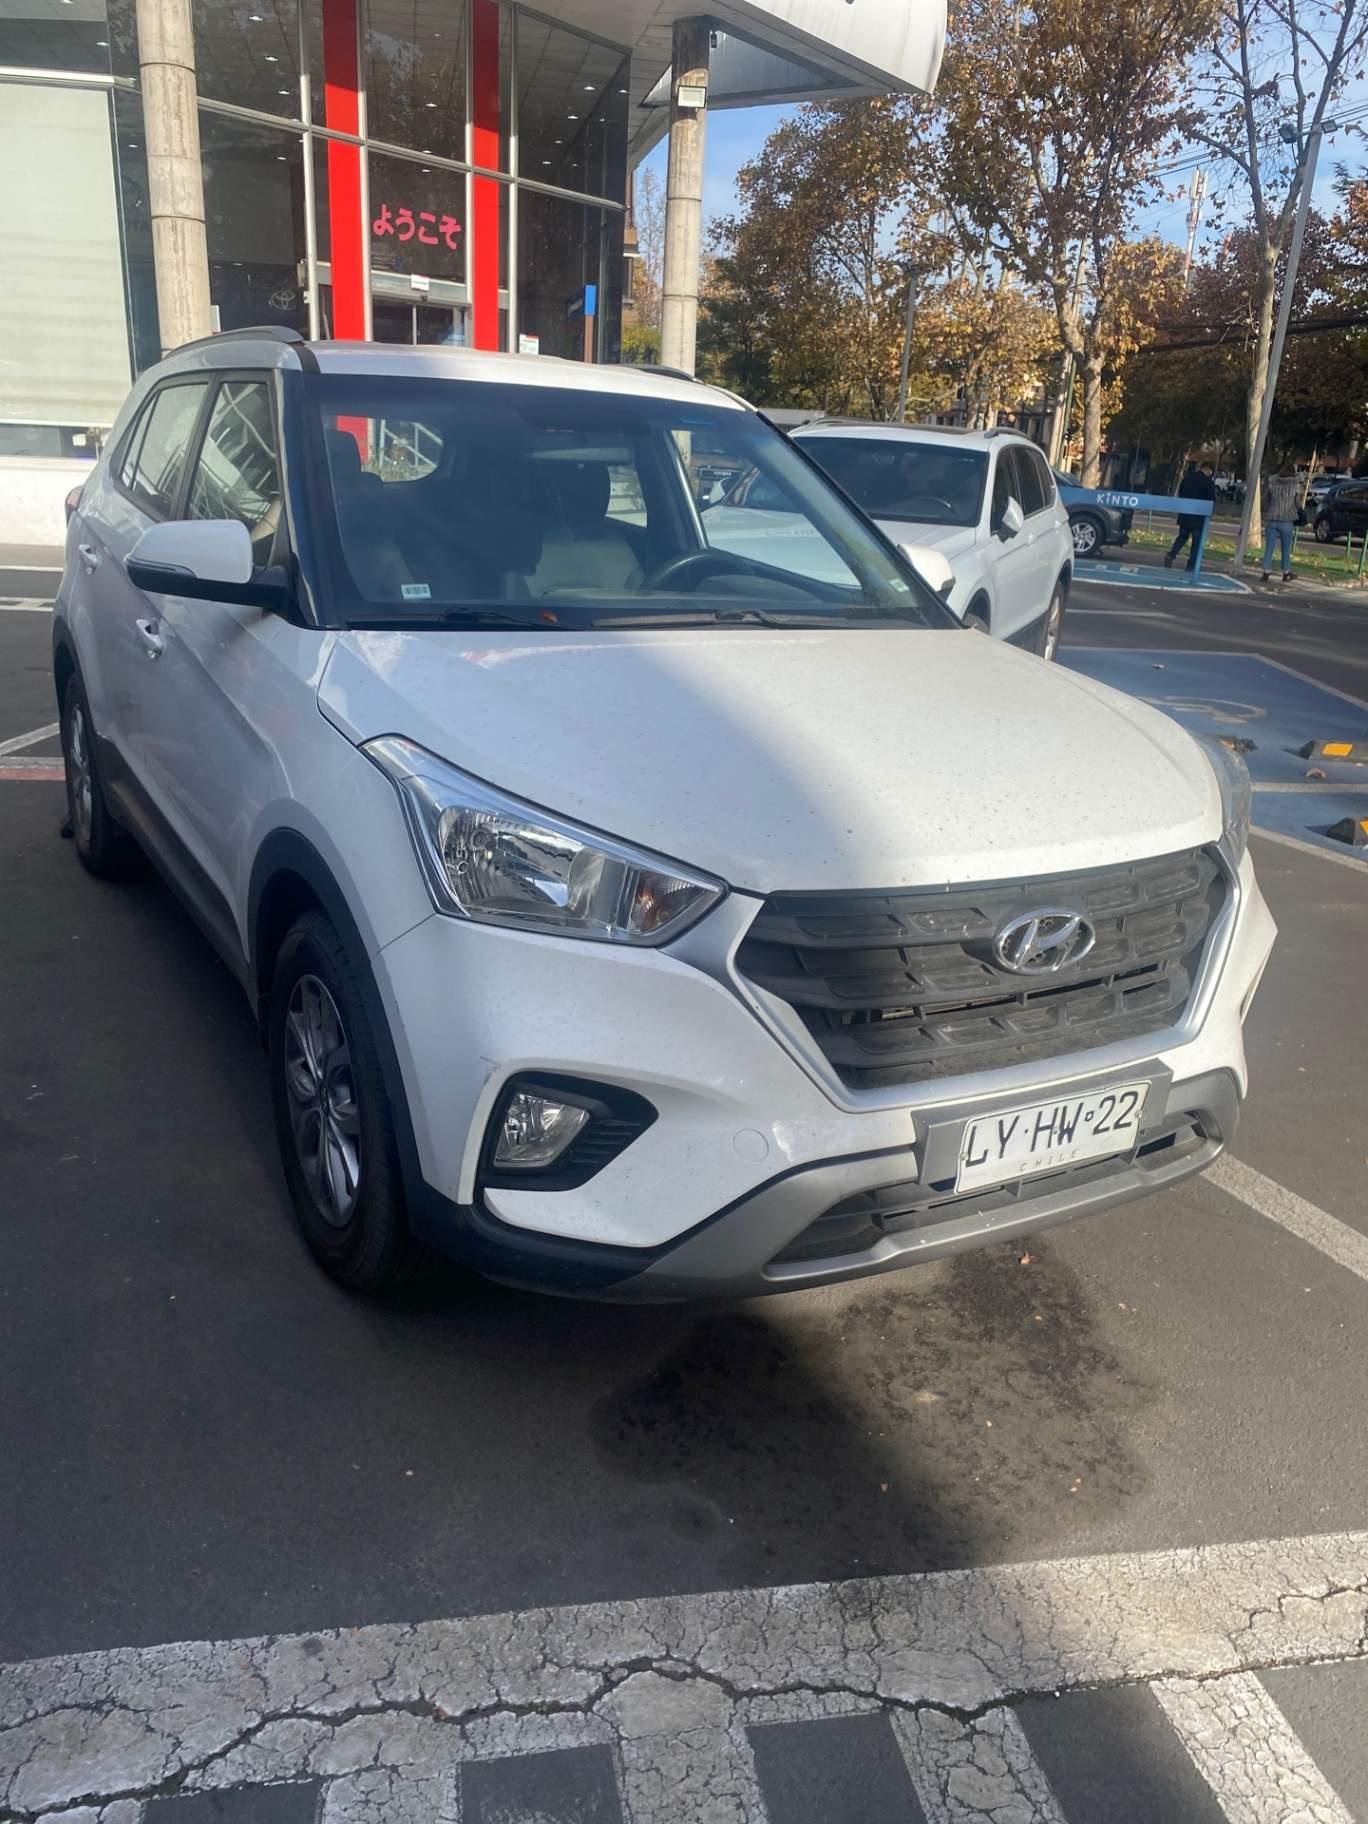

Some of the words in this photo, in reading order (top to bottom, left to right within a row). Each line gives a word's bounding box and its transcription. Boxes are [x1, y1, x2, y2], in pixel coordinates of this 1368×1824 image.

[373, 203, 462, 250] ようこそ
[1019, 1150, 1079, 1172] CHILE
